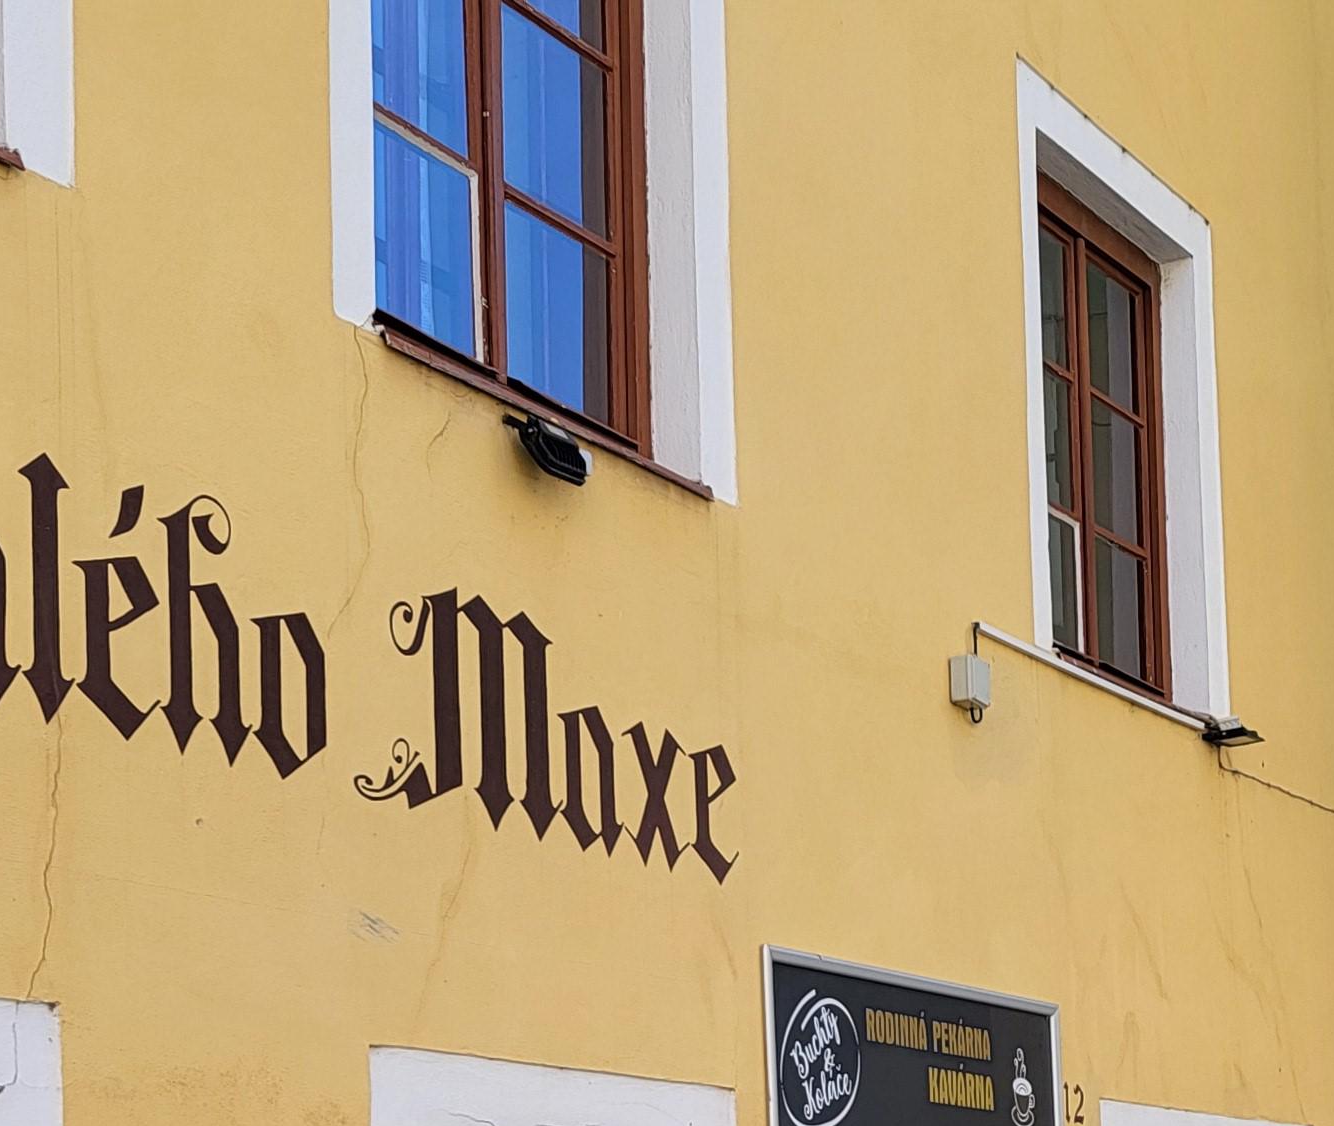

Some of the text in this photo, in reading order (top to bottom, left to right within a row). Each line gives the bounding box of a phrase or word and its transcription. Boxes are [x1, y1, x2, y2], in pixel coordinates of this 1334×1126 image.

[353, 585, 740, 886] Maxe
[789, 1006, 841, 1079] Buchty
[865, 1006, 992, 1061] RODINNÁ PEKÁRNA
[823, 1048, 835, 1078] &
[927, 1063, 995, 1112] KAVÁRNA
[802, 1064, 853, 1121] Koláče
[1063, 1081, 1085, 1125] 12
